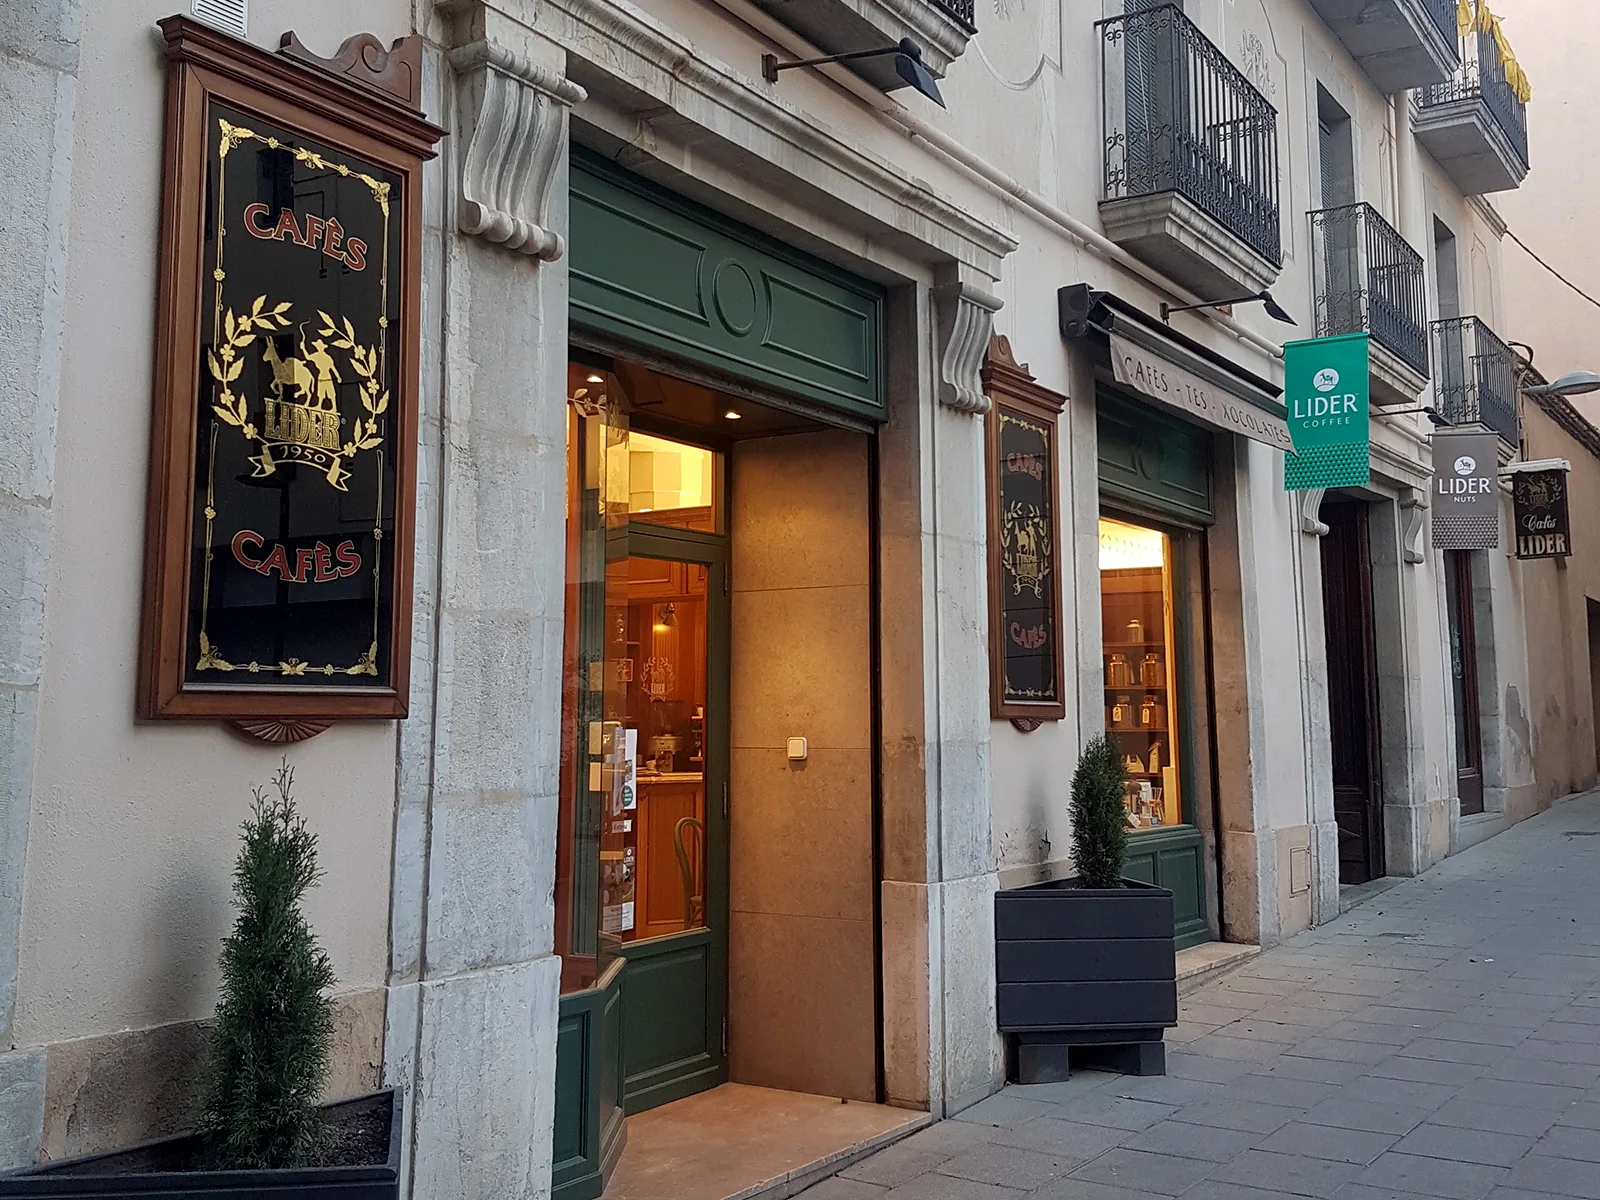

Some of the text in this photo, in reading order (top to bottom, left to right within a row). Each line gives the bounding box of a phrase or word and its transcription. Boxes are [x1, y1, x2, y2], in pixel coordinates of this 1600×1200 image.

[244, 202, 367, 271] CAFÈS
[1125, 356, 1168, 393] CAFÈS
[1222, 401, 1291, 443] XOCOLATES
[1294, 393, 1359, 419] LIDER
[264, 397, 341, 451] LIDER
[1302, 417, 1351, 429] COFFEE
[279, 445, 326, 463] 1950
[1438, 477, 1492, 494] LIDER
[1453, 495, 1477, 503] NUTS
[231, 529, 362, 583] CAFÈS
[1517, 532, 1567, 556] LIDER
